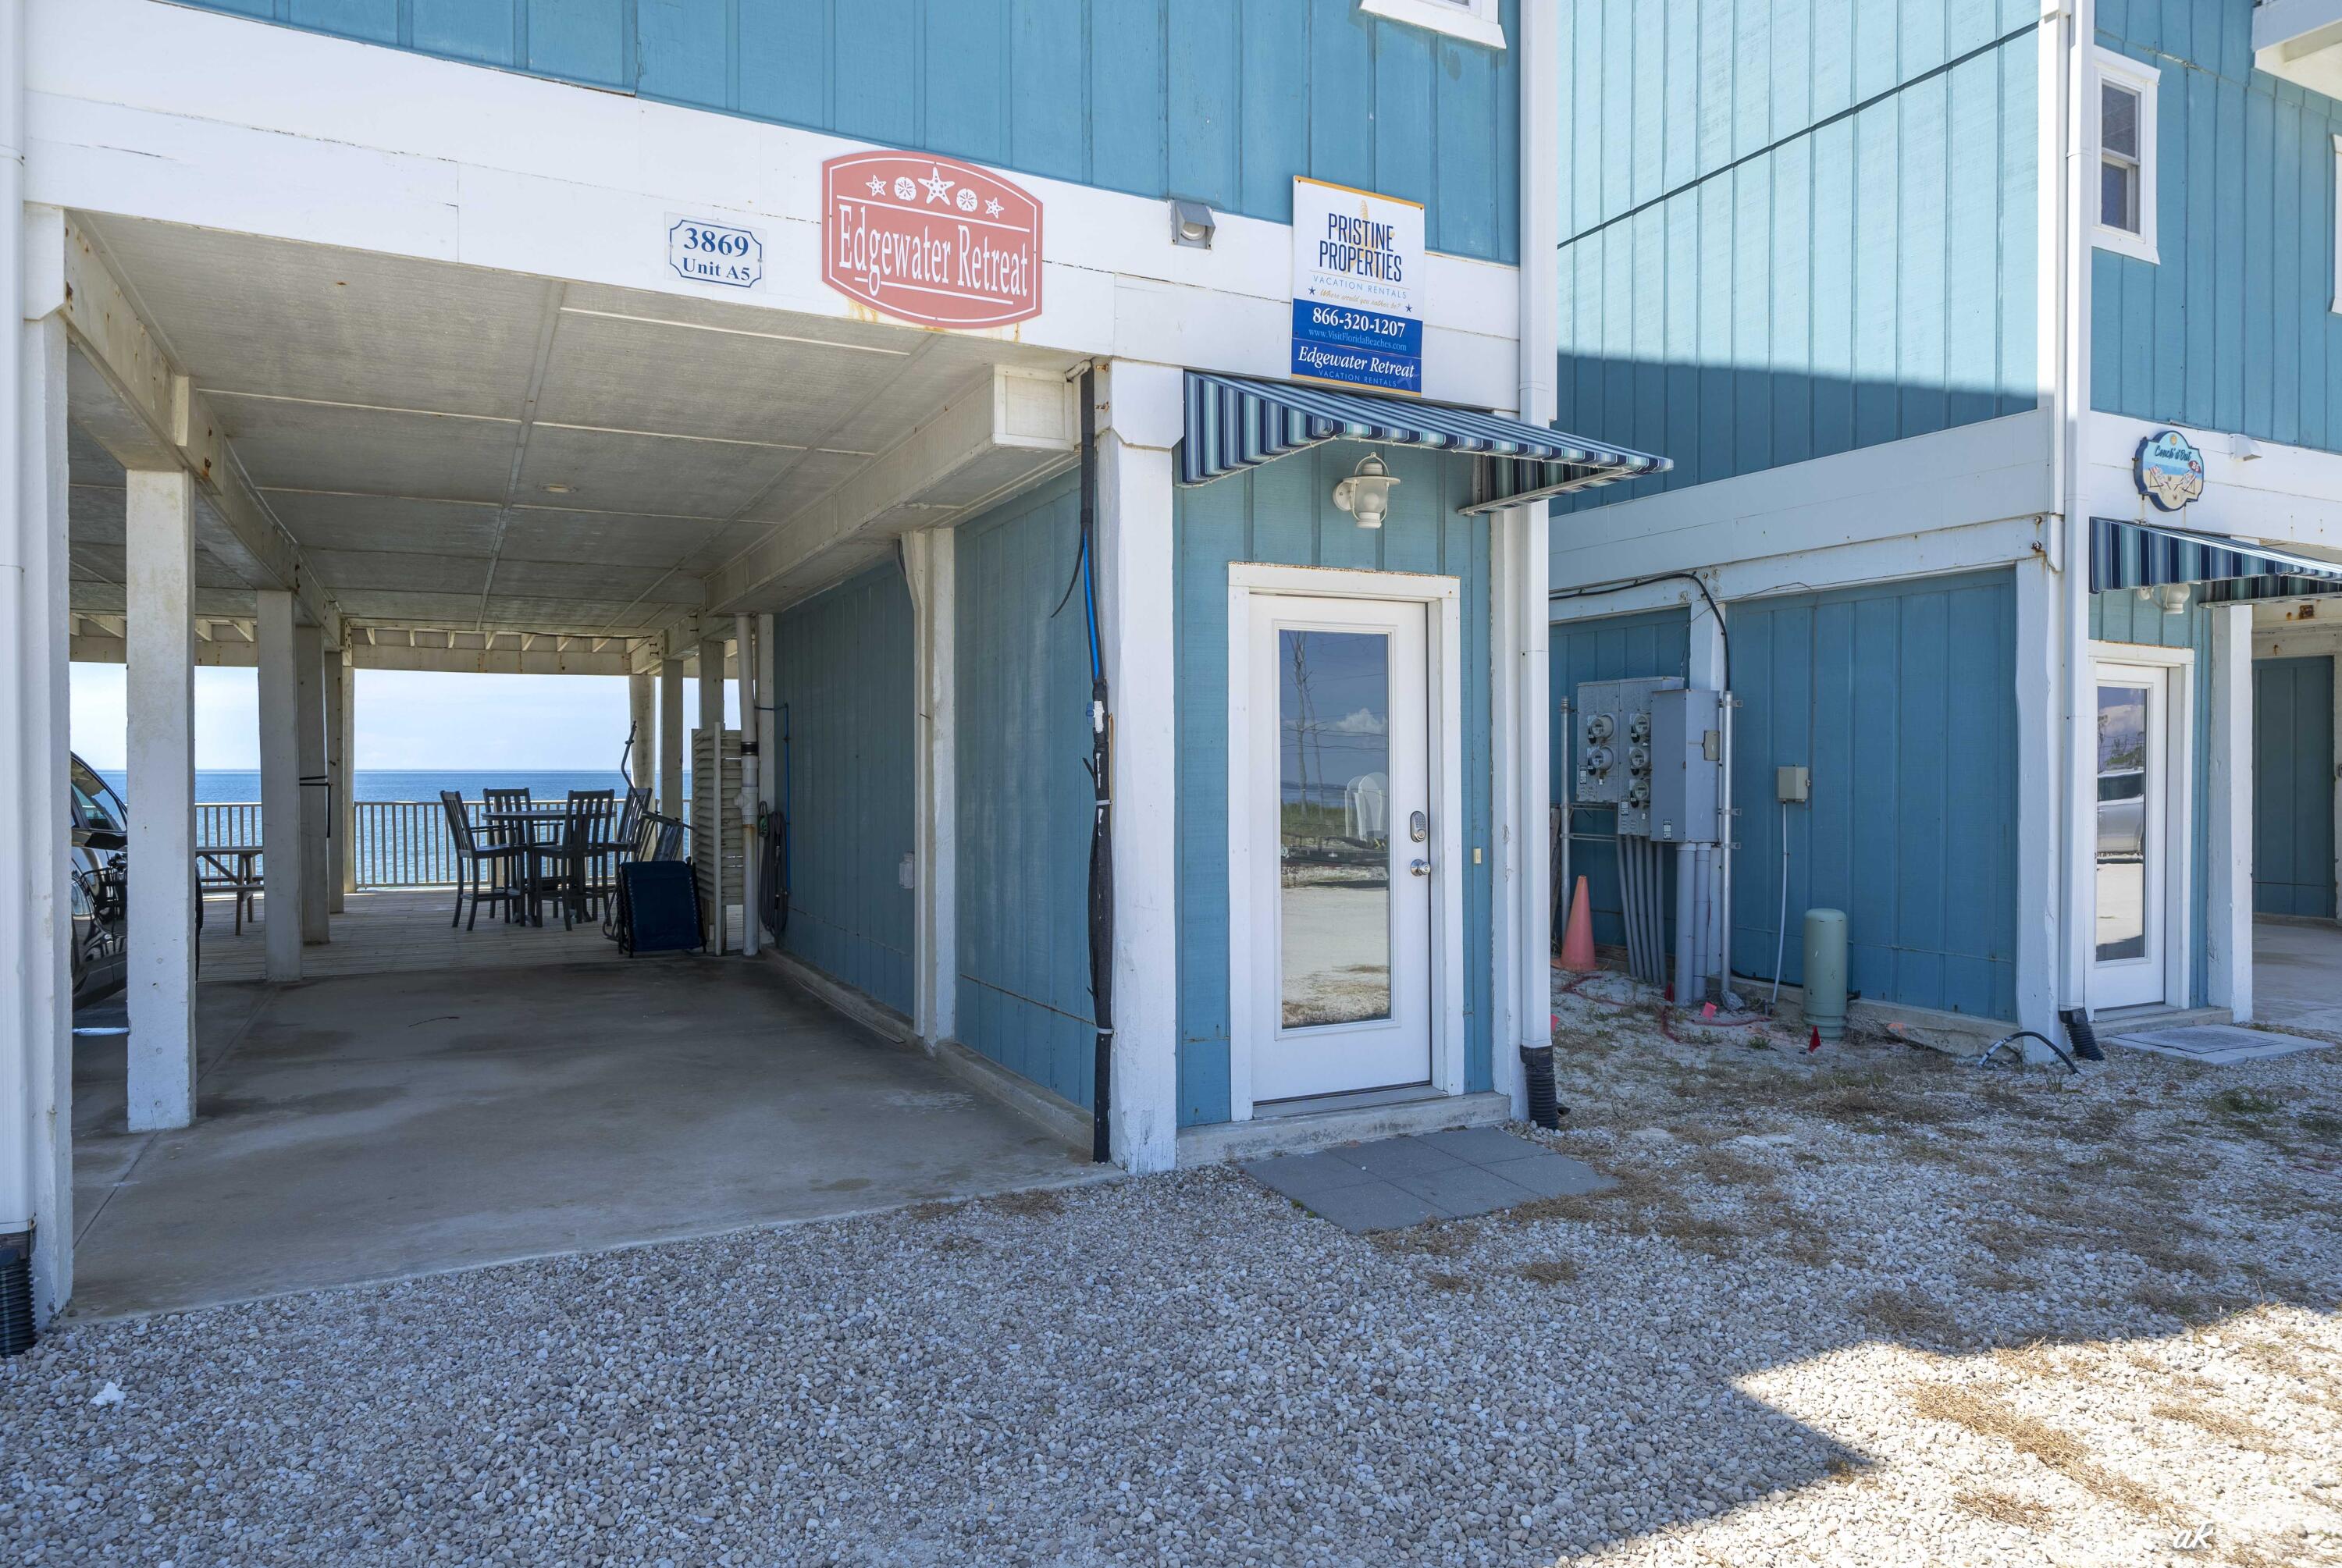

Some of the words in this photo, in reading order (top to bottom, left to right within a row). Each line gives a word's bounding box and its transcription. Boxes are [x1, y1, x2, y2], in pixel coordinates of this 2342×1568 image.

[683, 227, 749, 258] 3869
[1328, 212, 1394, 252] PRISTINE
[838, 204, 952, 297] Edgewater
[957, 224, 1028, 297] Retreat
[1319, 240, 1403, 283] PROPERTIES
[682, 257, 722, 277] Unit
[725, 265, 751, 281] A5
[1312, 274, 1364, 291] VACATION
[1368, 284, 1408, 300] RENTALS
[1312, 307, 1407, 338] 866-320-1207
[1308, 328, 1408, 351] www.VisitFloridaBeaches.com
[1298, 346, 1368, 369] Edgewater
[1369, 357, 1415, 379] Retreat
[1319, 369, 1361, 382] VACATION
[1364, 376, 1397, 388] RENTALS
